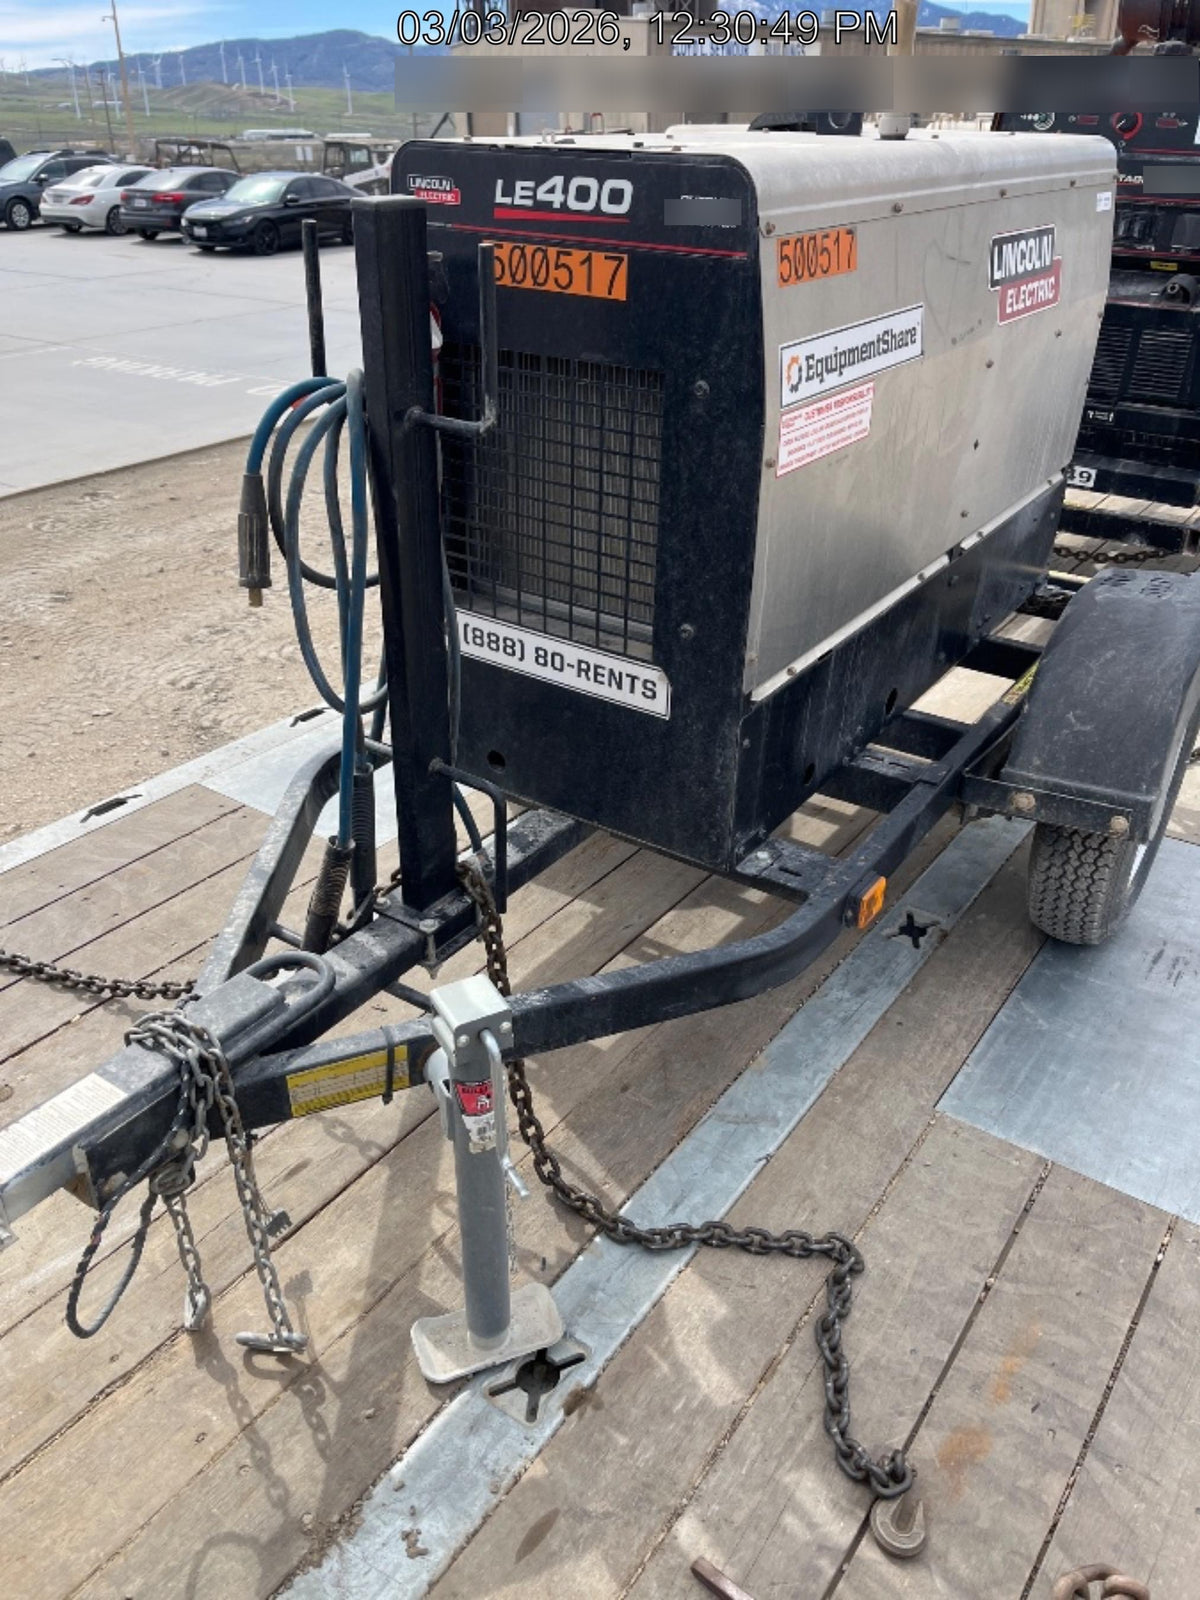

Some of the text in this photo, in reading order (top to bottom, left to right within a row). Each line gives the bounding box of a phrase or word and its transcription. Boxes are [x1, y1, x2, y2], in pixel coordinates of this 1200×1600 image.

[410, 177, 451, 192] LINCOLN
[419, 190, 456, 202] ELECTRIC
[494, 175, 633, 214] LE400
[779, 229, 854, 283] 500517
[993, 234, 1052, 280] LINCOLN
[1006, 276, 1055, 313] ELECTRIC
[805, 326, 917, 384] EquipmentShare
[463, 623, 657, 700] (888) 80-RENTS
